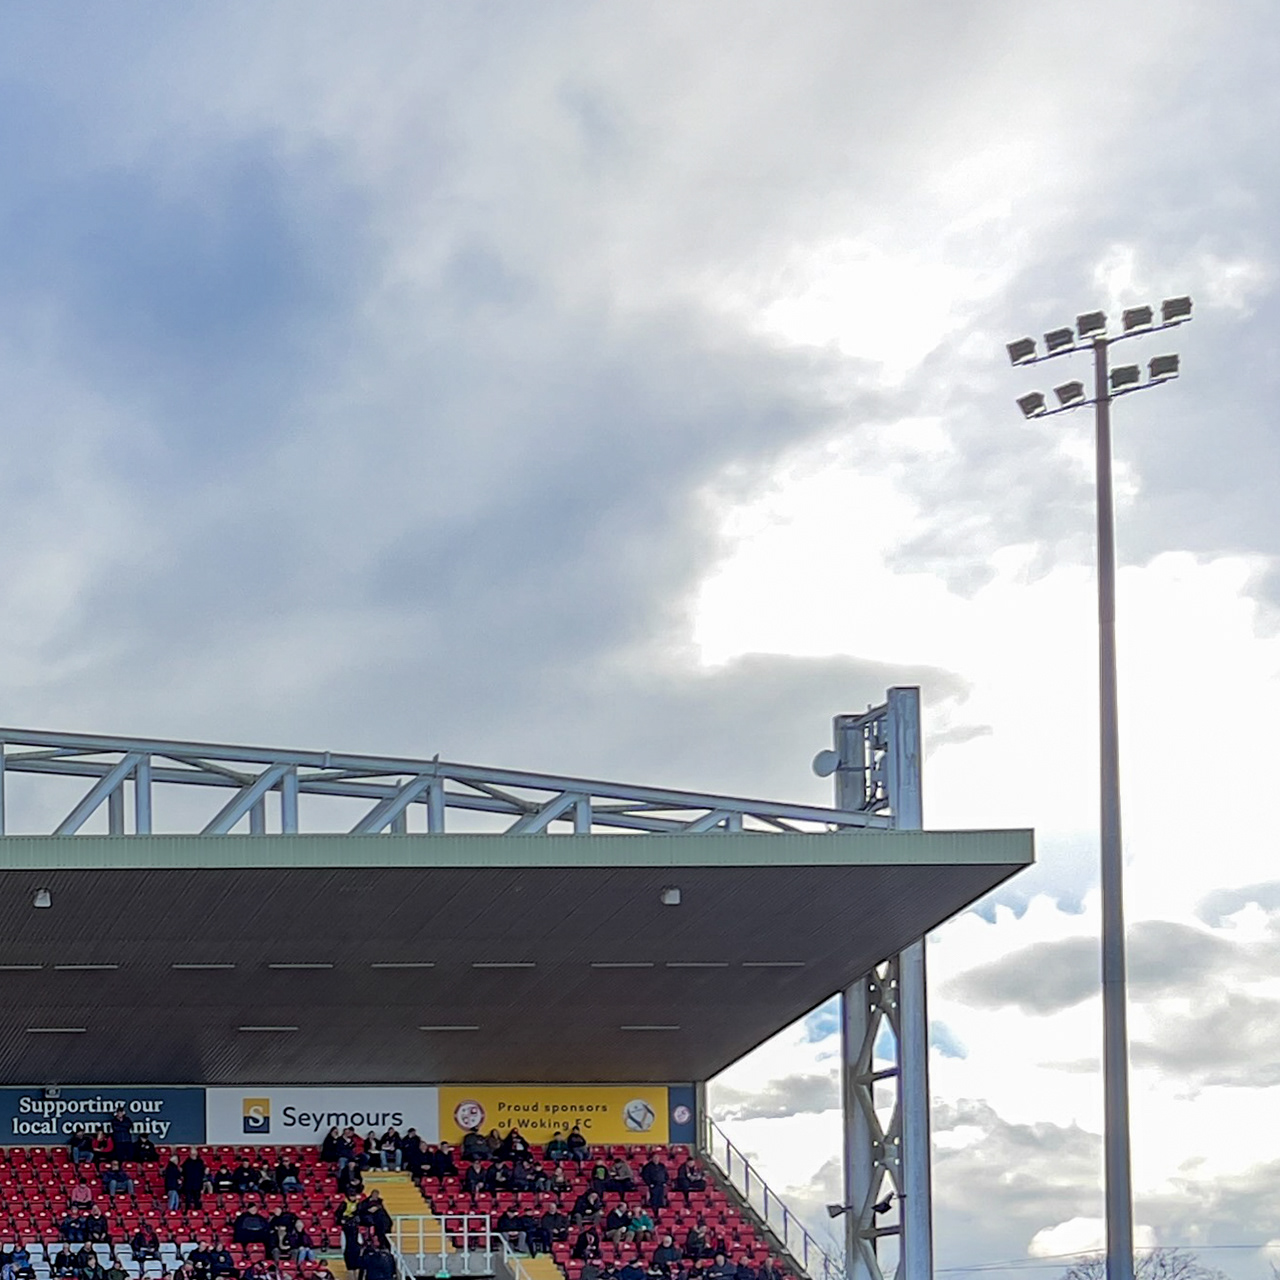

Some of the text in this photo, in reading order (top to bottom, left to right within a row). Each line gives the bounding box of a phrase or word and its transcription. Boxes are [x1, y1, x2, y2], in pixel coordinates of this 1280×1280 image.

[130, 1099, 163, 1114] our
[498, 1102, 608, 1115] Proud sponsors
[12, 1118, 58, 1135] local
[282, 1106, 403, 1132] Seymours
[498, 1118, 592, 1132] of Woking FC
